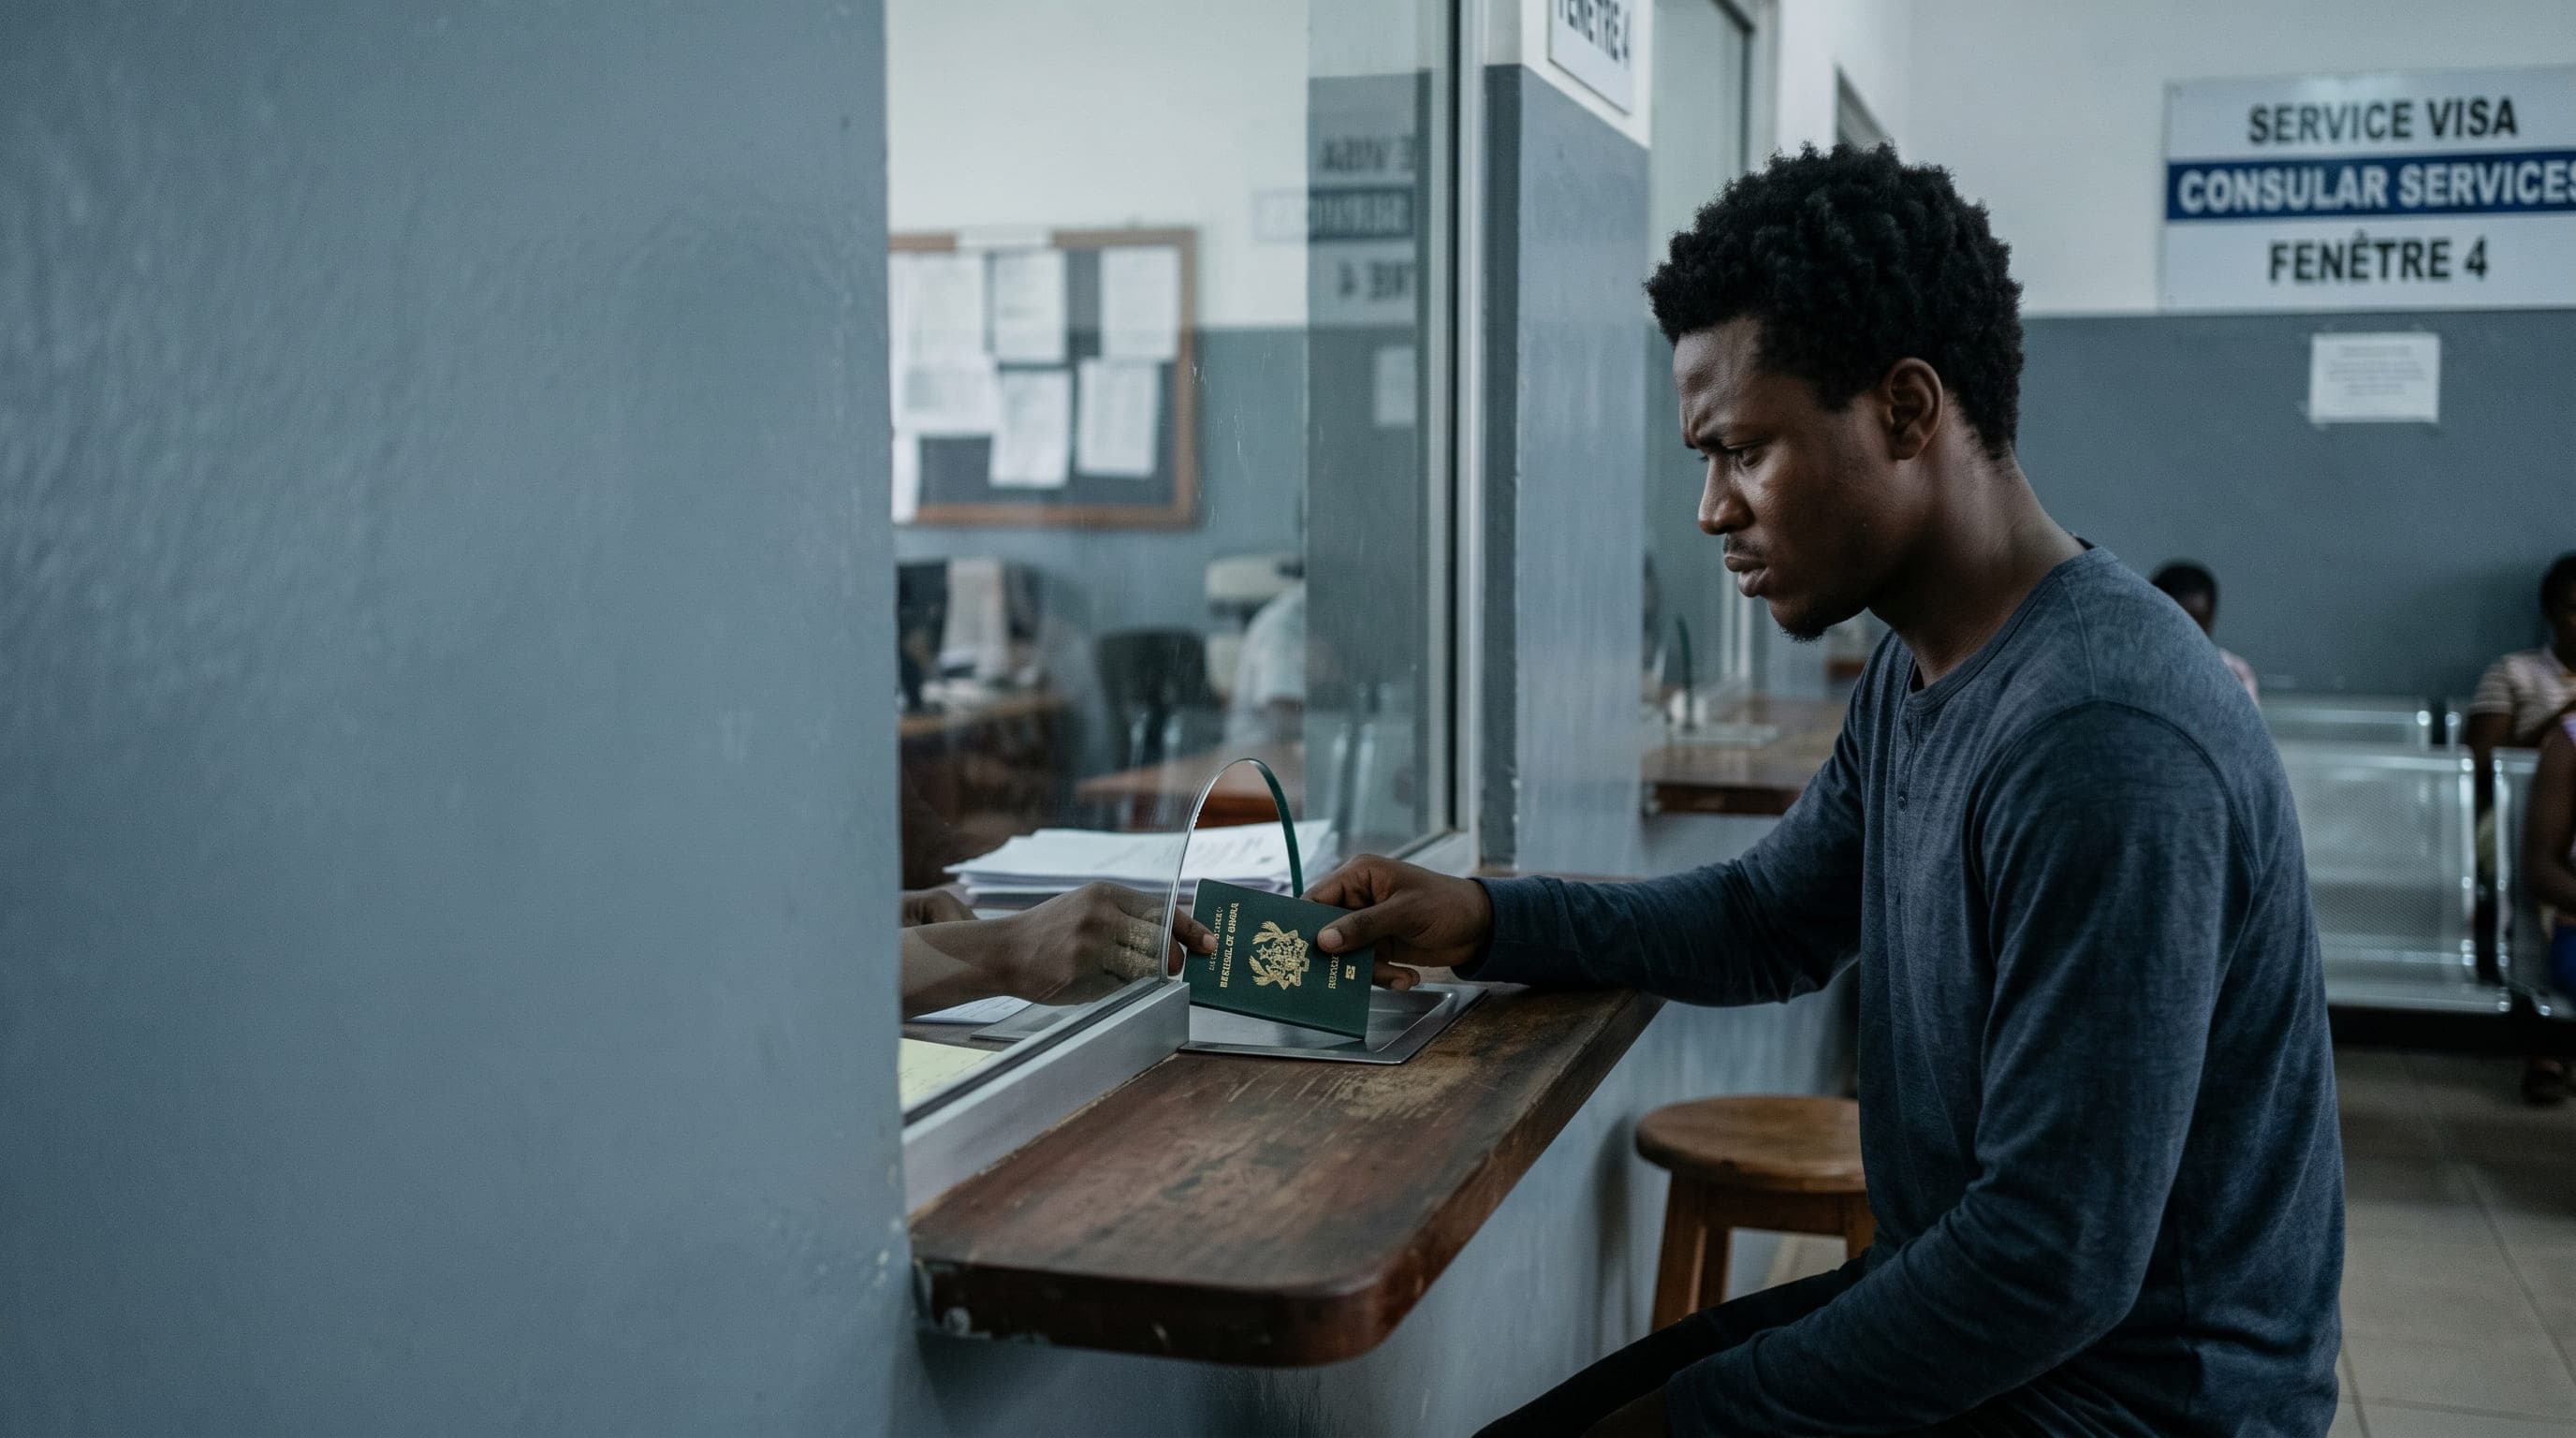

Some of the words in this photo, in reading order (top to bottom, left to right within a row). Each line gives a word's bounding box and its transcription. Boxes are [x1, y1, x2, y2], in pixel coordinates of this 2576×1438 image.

[2249, 102, 2413, 146] SERVICE
[2428, 96, 2518, 139] VISA
[2178, 165, 2389, 214] CONSULAR
[2269, 228, 2452, 282] FENÊTRE
[2465, 235, 2489, 278] 4
